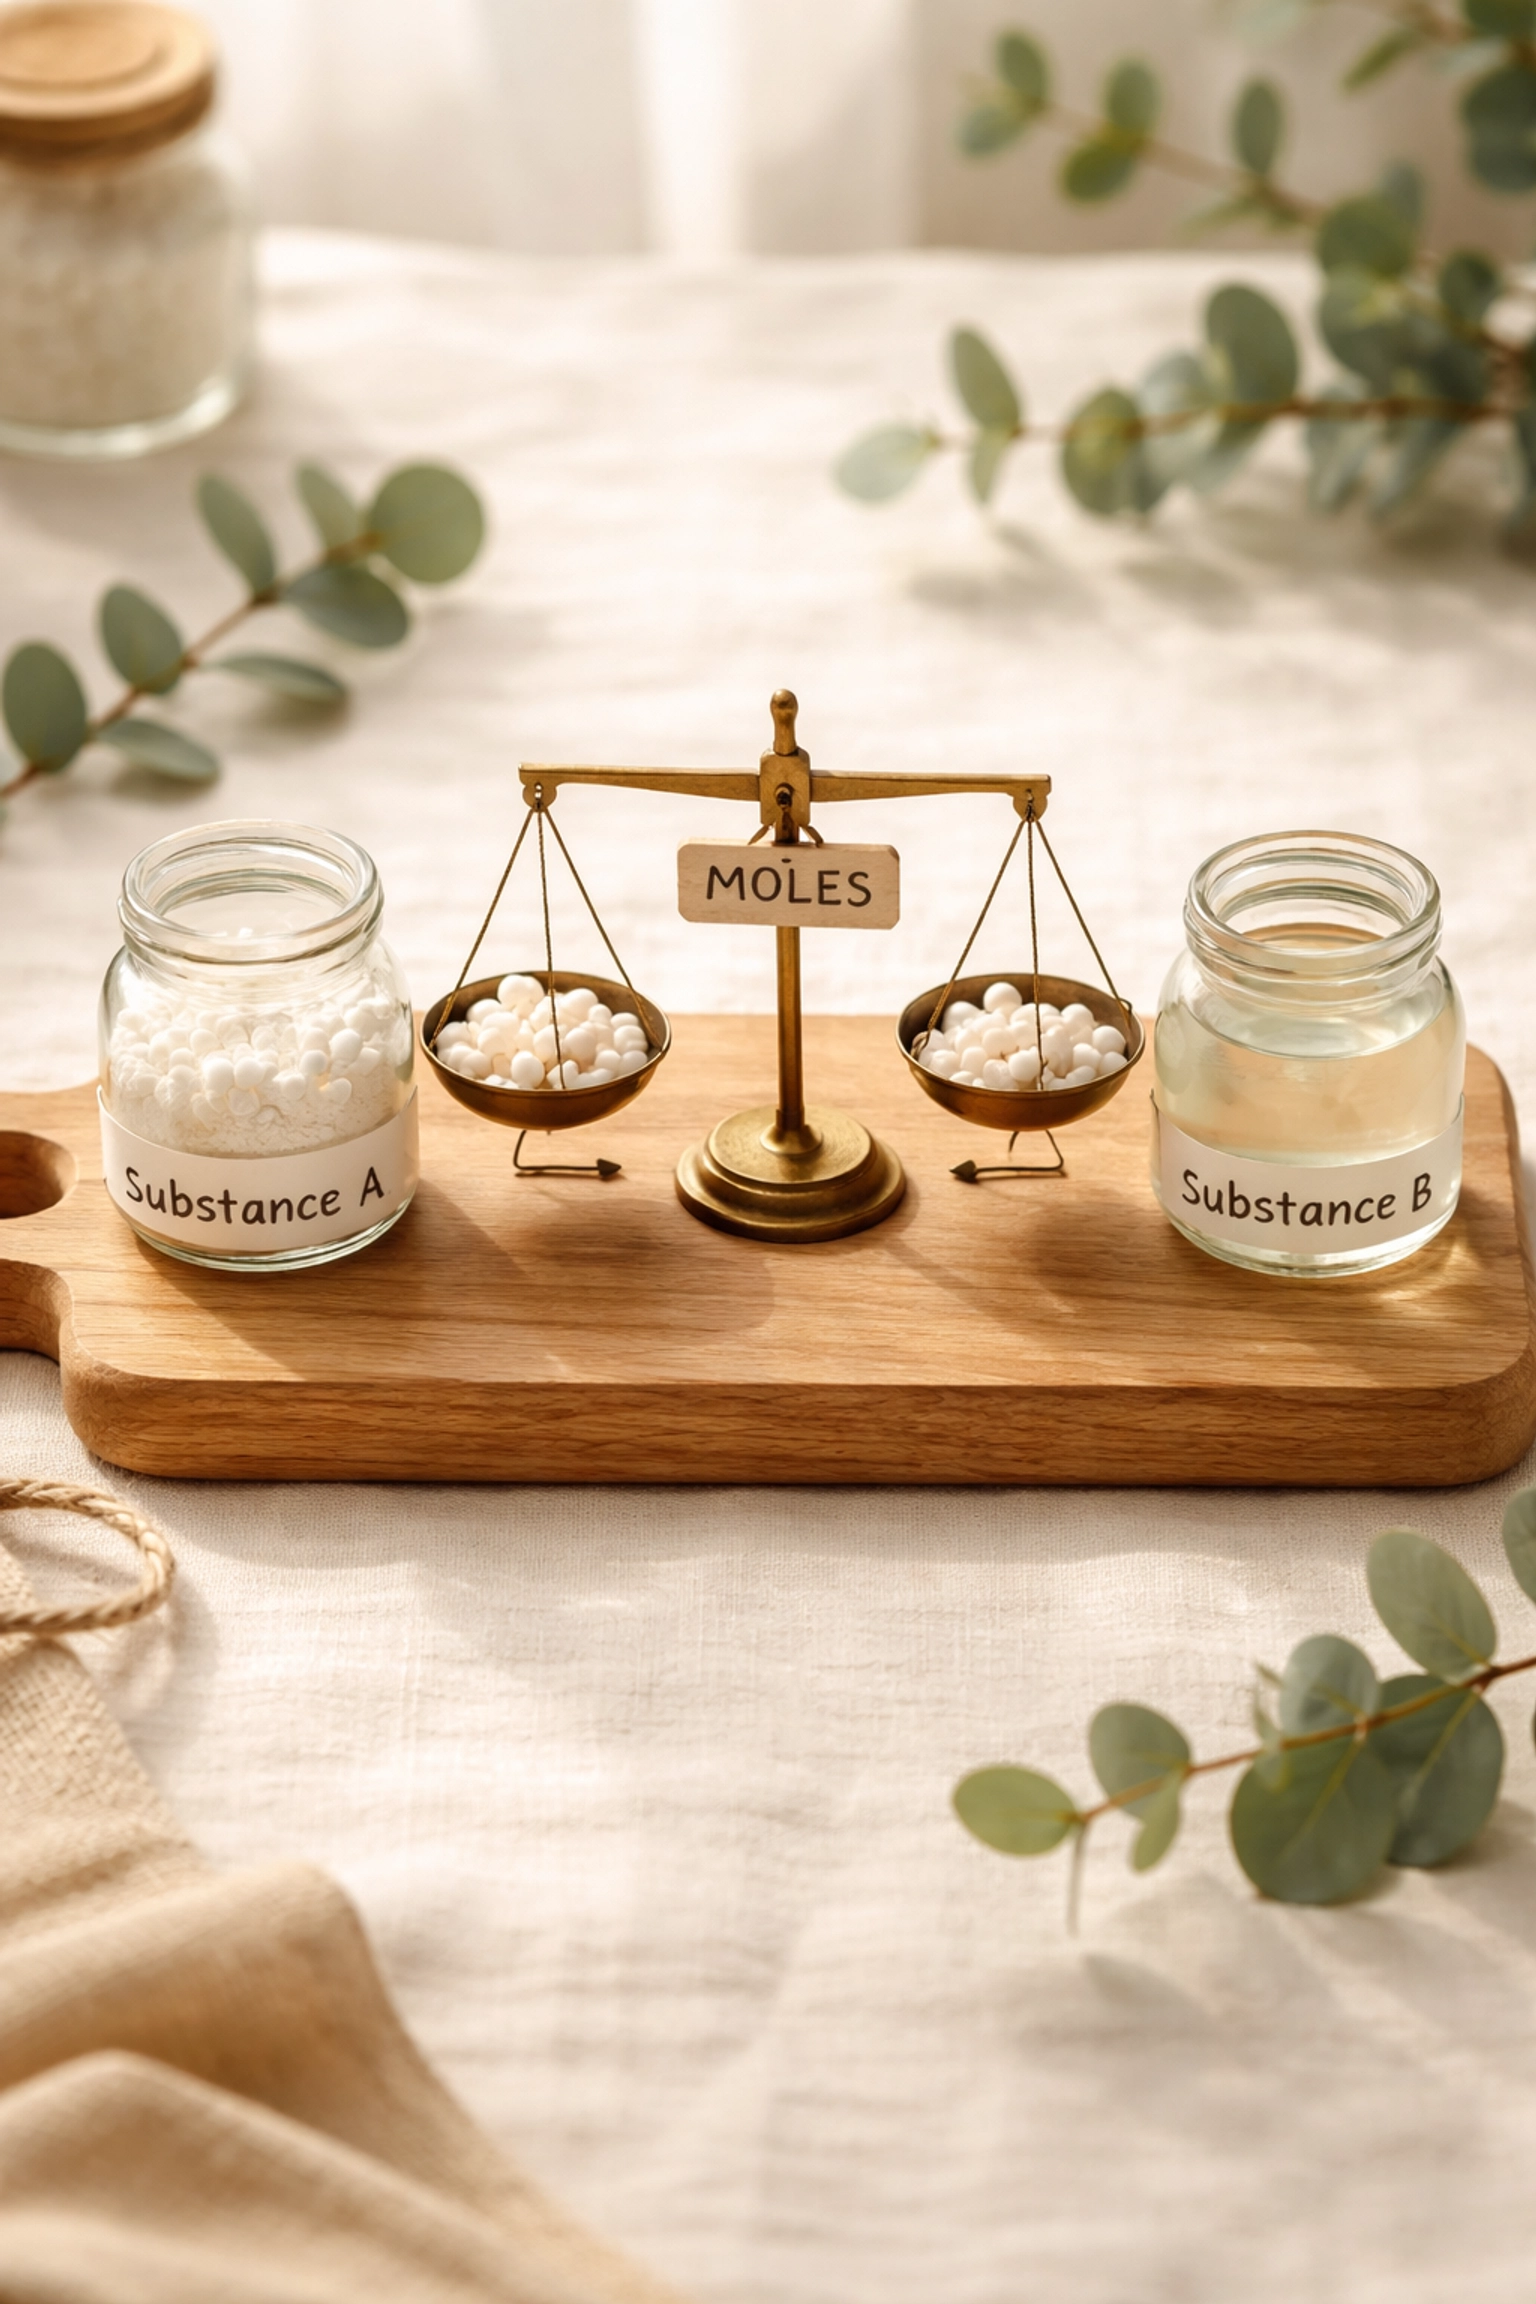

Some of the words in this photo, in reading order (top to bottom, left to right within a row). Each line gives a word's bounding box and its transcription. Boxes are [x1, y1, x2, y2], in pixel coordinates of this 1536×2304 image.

[706, 865, 872, 908] MOLES
[125, 1166, 342, 1225] Substance
[359, 1166, 386, 1207] A
[1181, 1168, 1396, 1227] Substance
[1411, 1172, 1433, 1213] B
